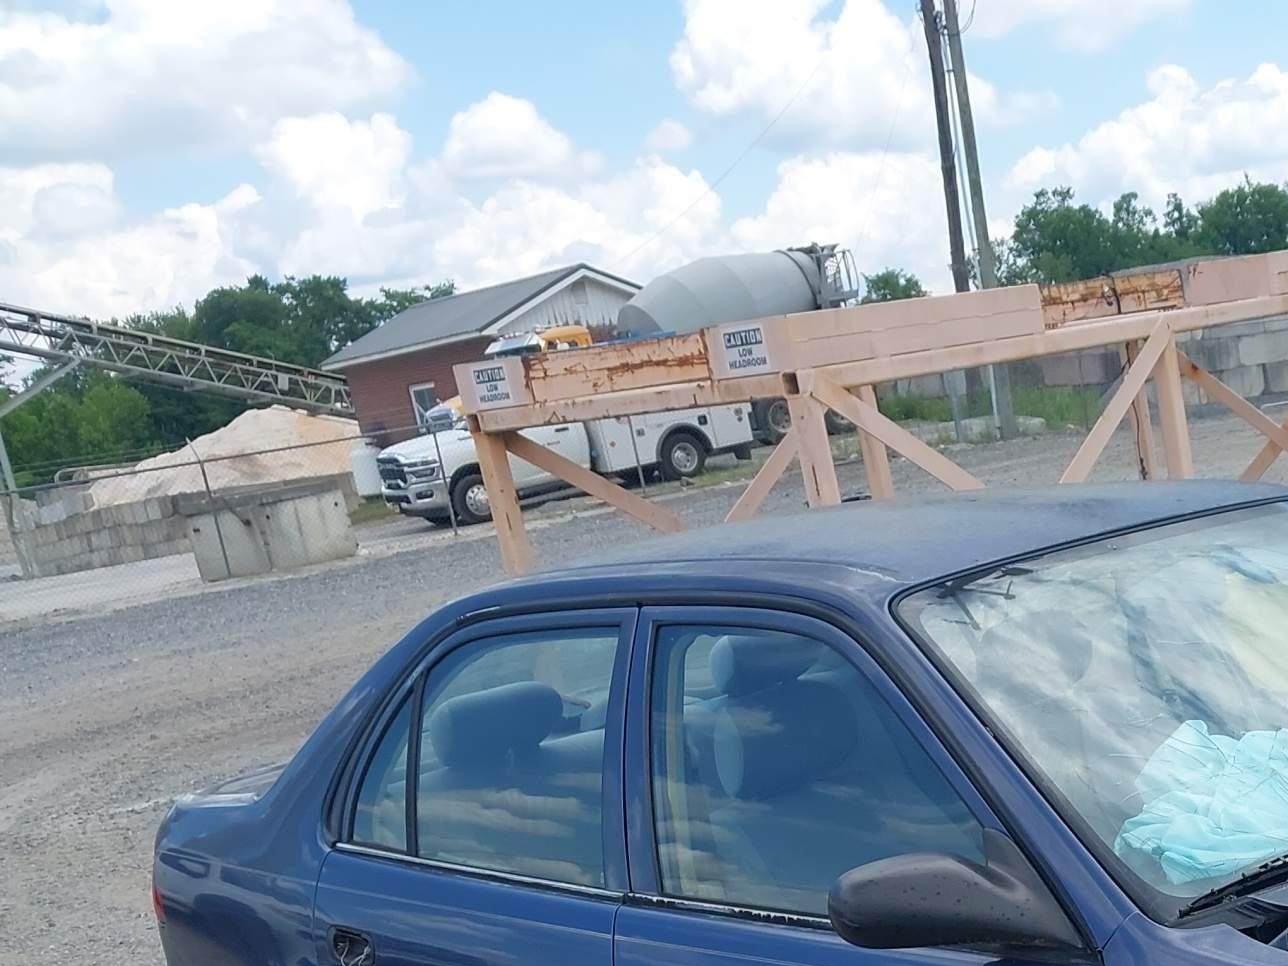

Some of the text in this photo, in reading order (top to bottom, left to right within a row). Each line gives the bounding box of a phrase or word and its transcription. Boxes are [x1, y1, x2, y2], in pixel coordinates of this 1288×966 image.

[723, 329, 763, 347] CAUTION
[738, 347, 752, 357] LOW
[729, 356, 767, 369] HEADROOM
[474, 368, 505, 382] CAUTION
